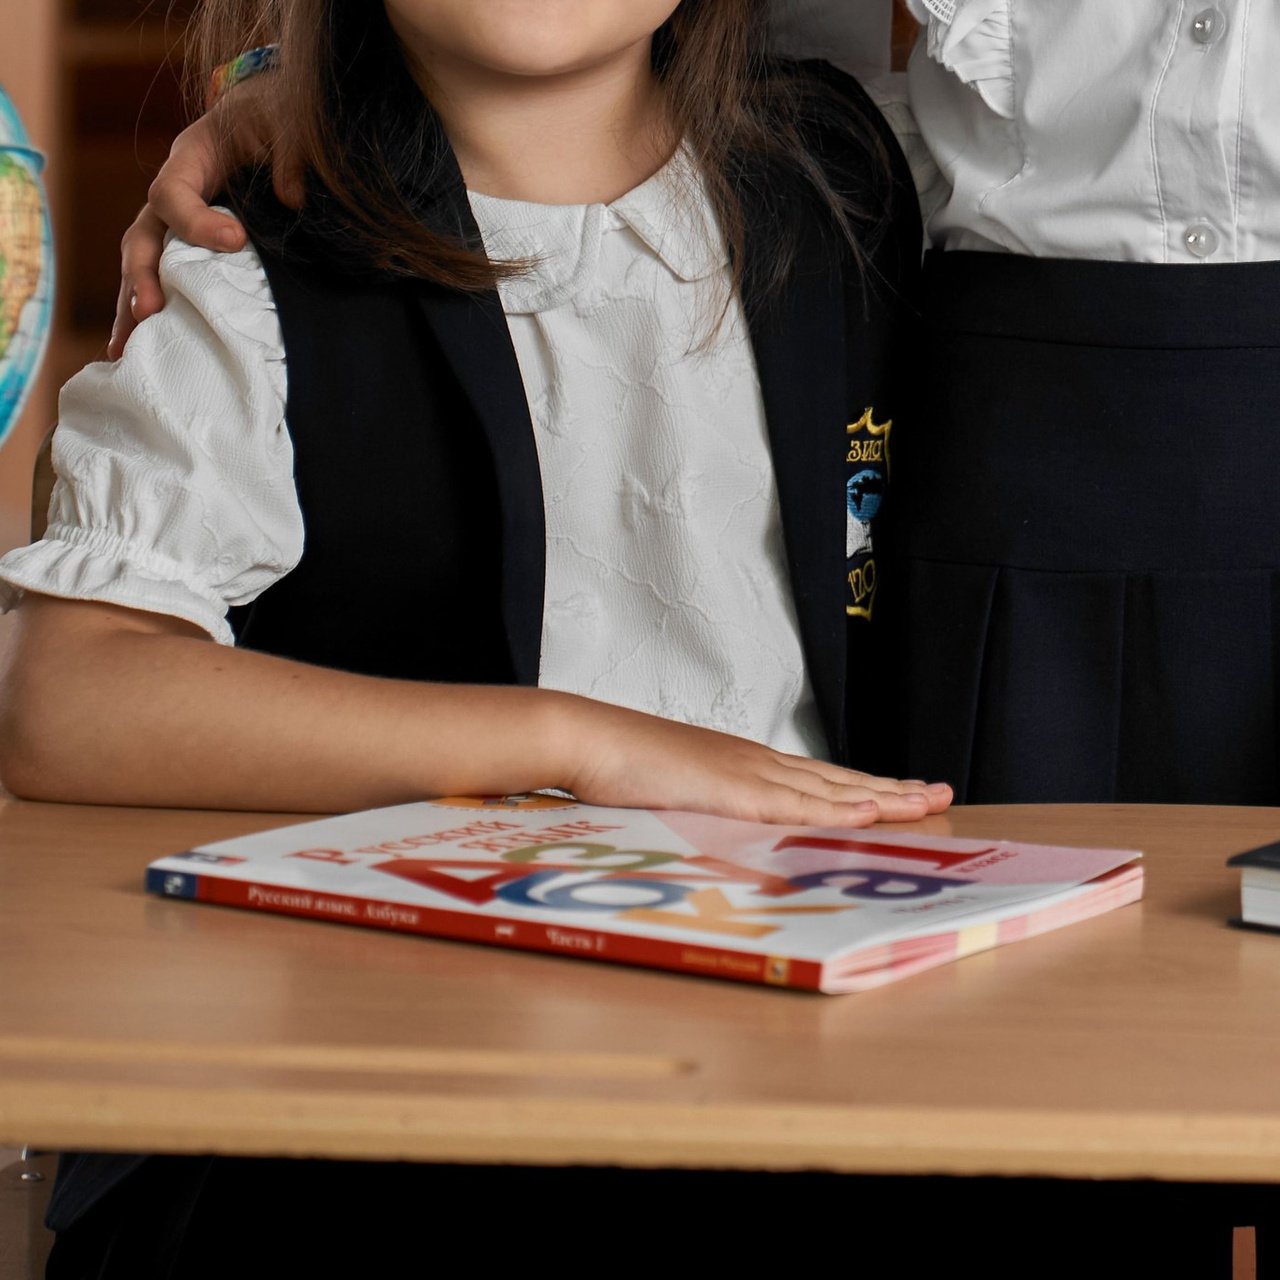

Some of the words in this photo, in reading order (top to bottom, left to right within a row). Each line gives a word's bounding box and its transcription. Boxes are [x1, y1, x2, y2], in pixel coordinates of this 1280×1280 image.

[847, 439, 883, 462] зия
[848, 559, 876, 603] 120
[248, 885, 313, 909] Русский
